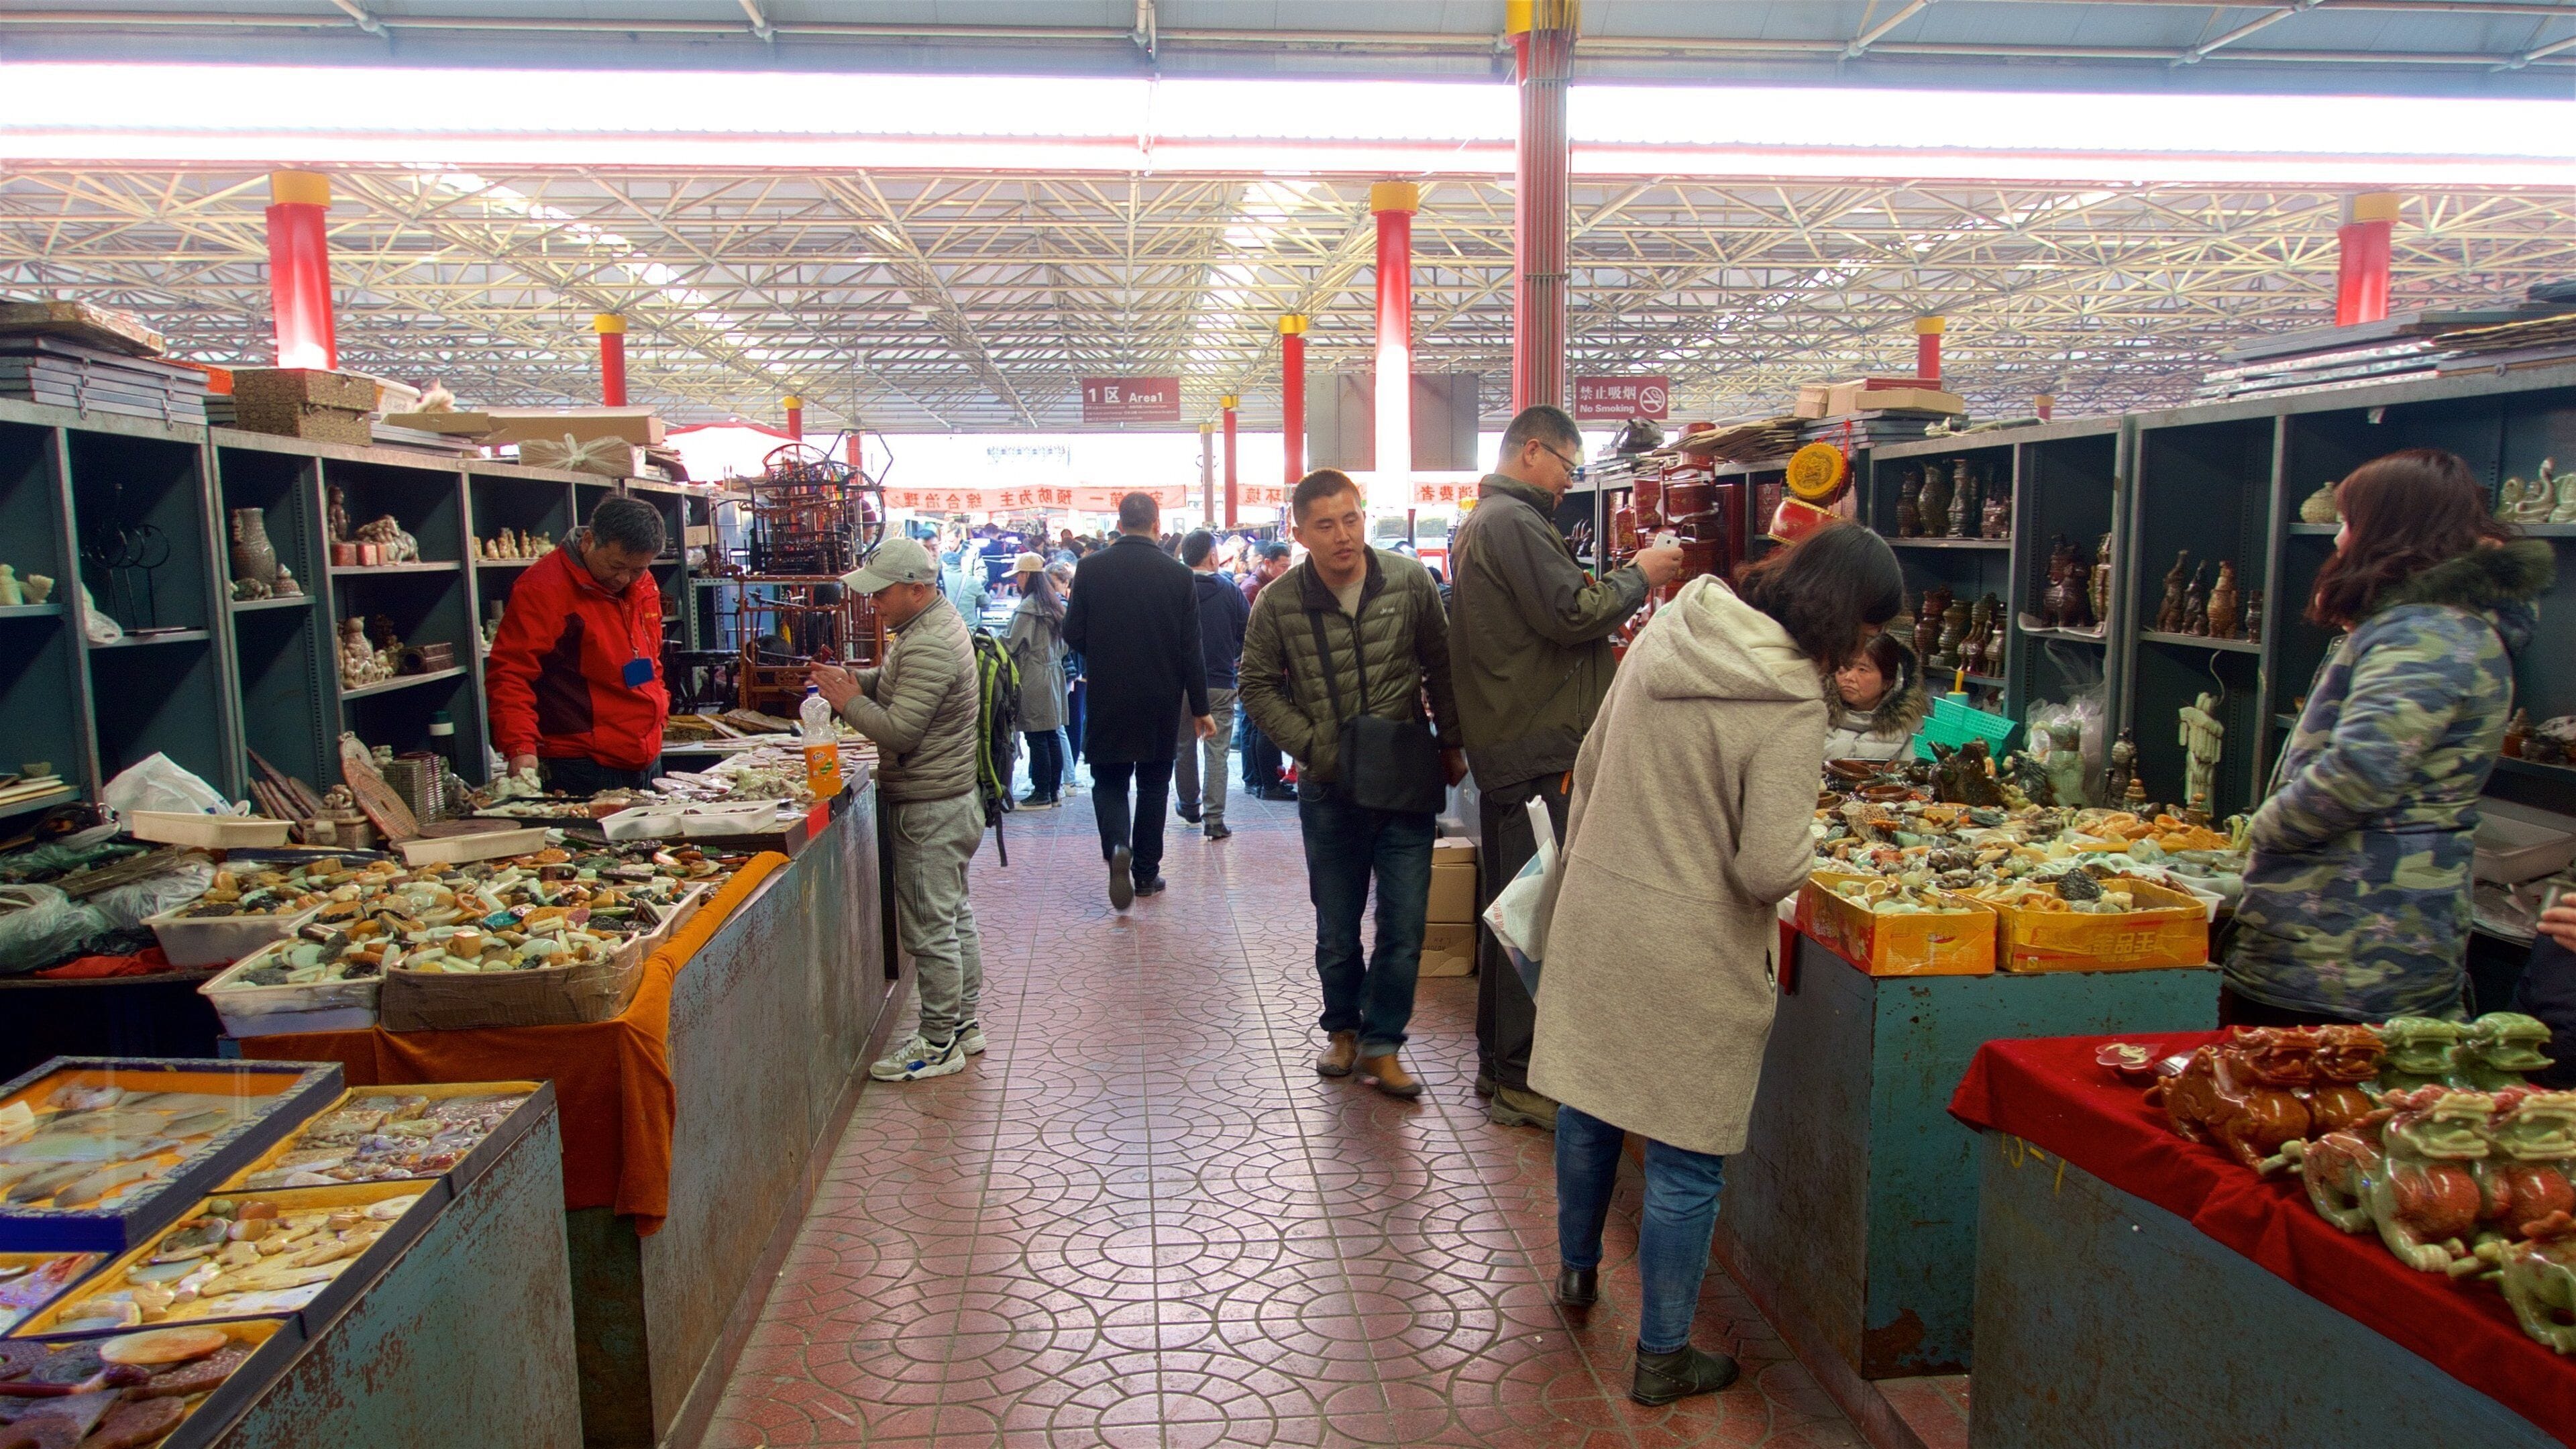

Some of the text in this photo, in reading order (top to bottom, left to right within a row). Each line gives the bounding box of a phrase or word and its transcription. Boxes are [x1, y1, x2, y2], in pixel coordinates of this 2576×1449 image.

[1104, 386, 1120, 402] 区
[1128, 392, 1163, 402] Area1
[1580, 386, 1637, 400] 禁止吸烟
[1580, 404, 1635, 414] No Smoking
